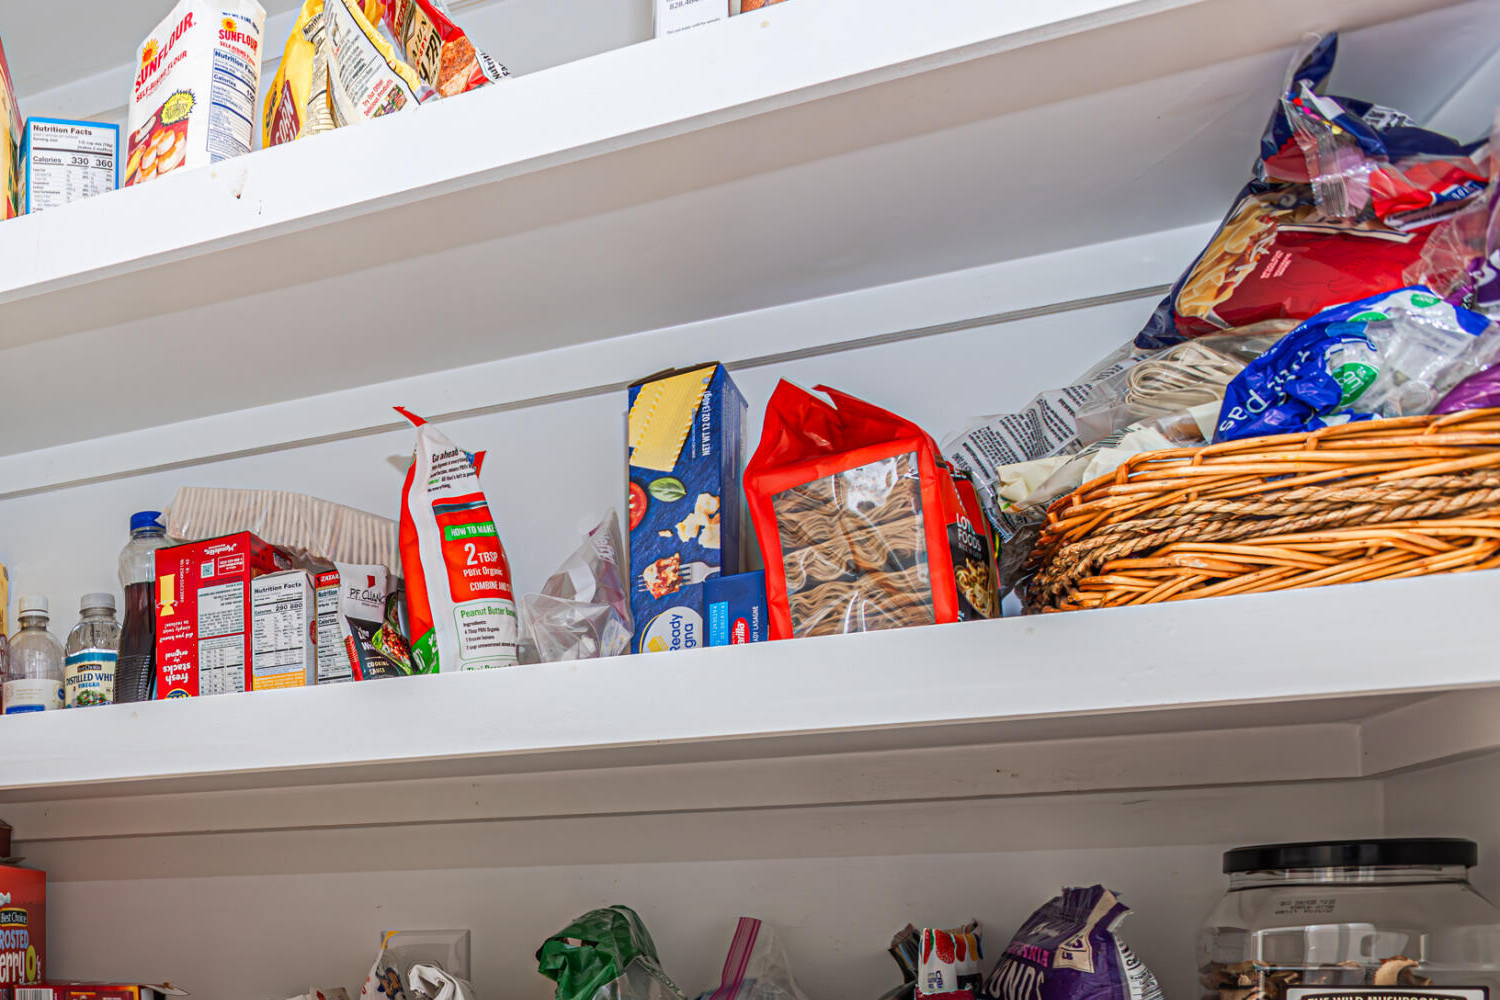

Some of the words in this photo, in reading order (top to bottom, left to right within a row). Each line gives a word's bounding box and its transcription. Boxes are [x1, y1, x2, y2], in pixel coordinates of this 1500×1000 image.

[218, 29, 258, 51] SUNFLOUR
[134, 11, 193, 93] SUNFLOUR
[33, 124, 68, 134] Nutrition
[70, 128, 92, 136] Facts
[71, 156, 89, 165] 330
[96, 159, 113, 168] 360
[957, 526, 982, 552] FOODS
[464, 543, 478, 565] 2
[478, 552, 498, 563] TBSP
[254, 586, 282, 594] Nutrition
[460, 608, 486, 618] Peanut
[488, 606, 505, 616] Butter
[165, 649, 189, 660] original
[162, 662, 191, 675] stacks
[66, 674, 93, 686] DISTILLED
[96, 673, 114, 681] WHIT
